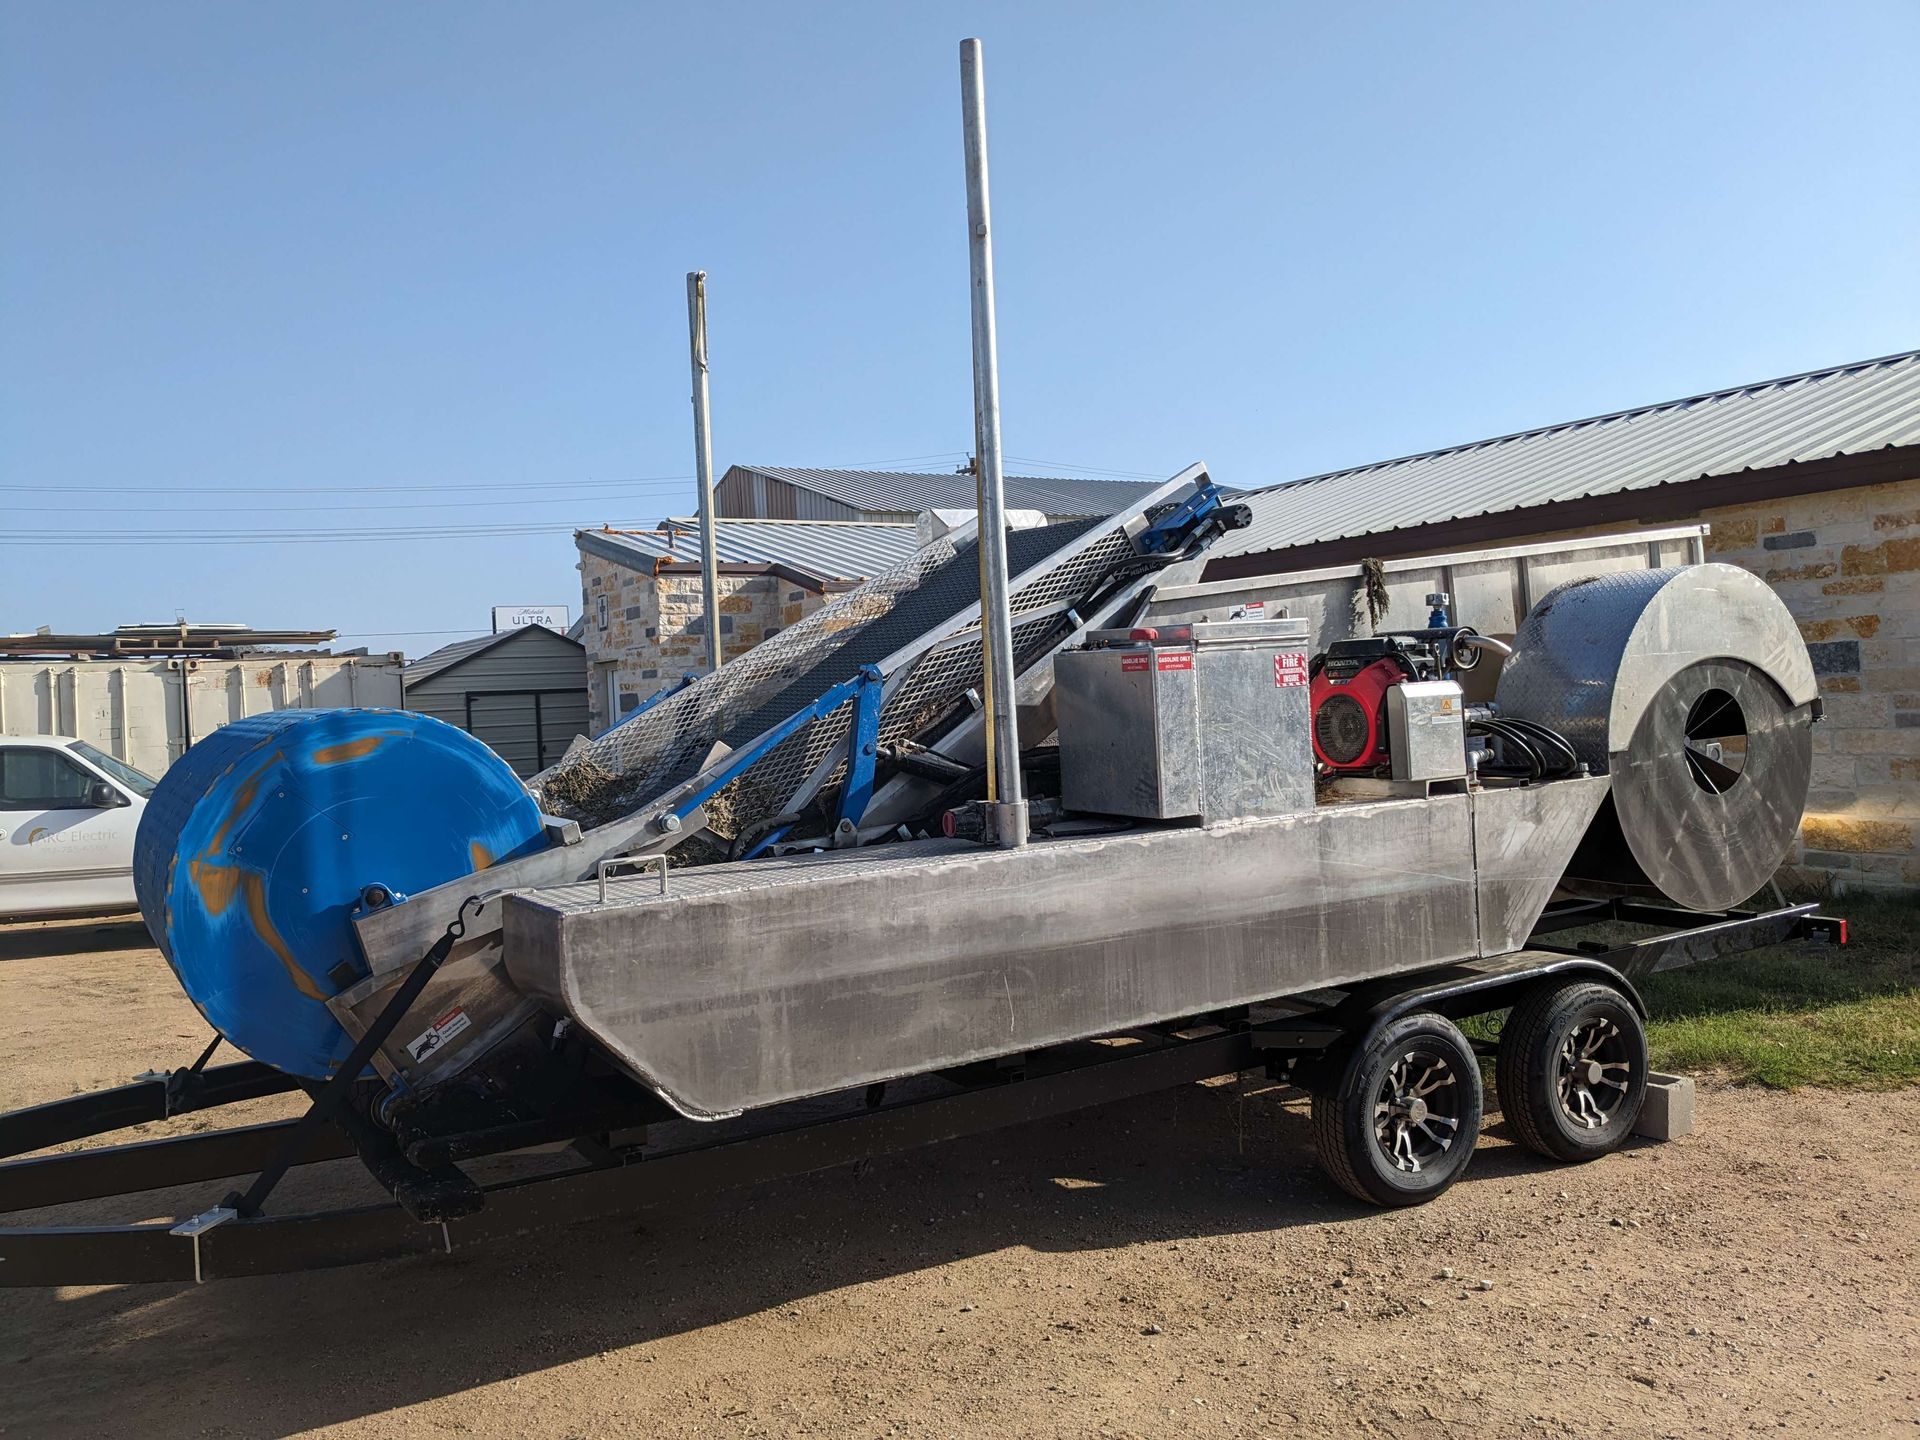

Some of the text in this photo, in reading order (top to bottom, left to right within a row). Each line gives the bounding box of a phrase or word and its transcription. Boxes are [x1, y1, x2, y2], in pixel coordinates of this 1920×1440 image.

[512, 616, 553, 625] ULTRA
[1158, 656, 1179, 664] GASOLINE
[1282, 657, 1299, 668] FIRE
[1327, 659, 1359, 667] HONDA
[71, 829, 119, 843] Electric
